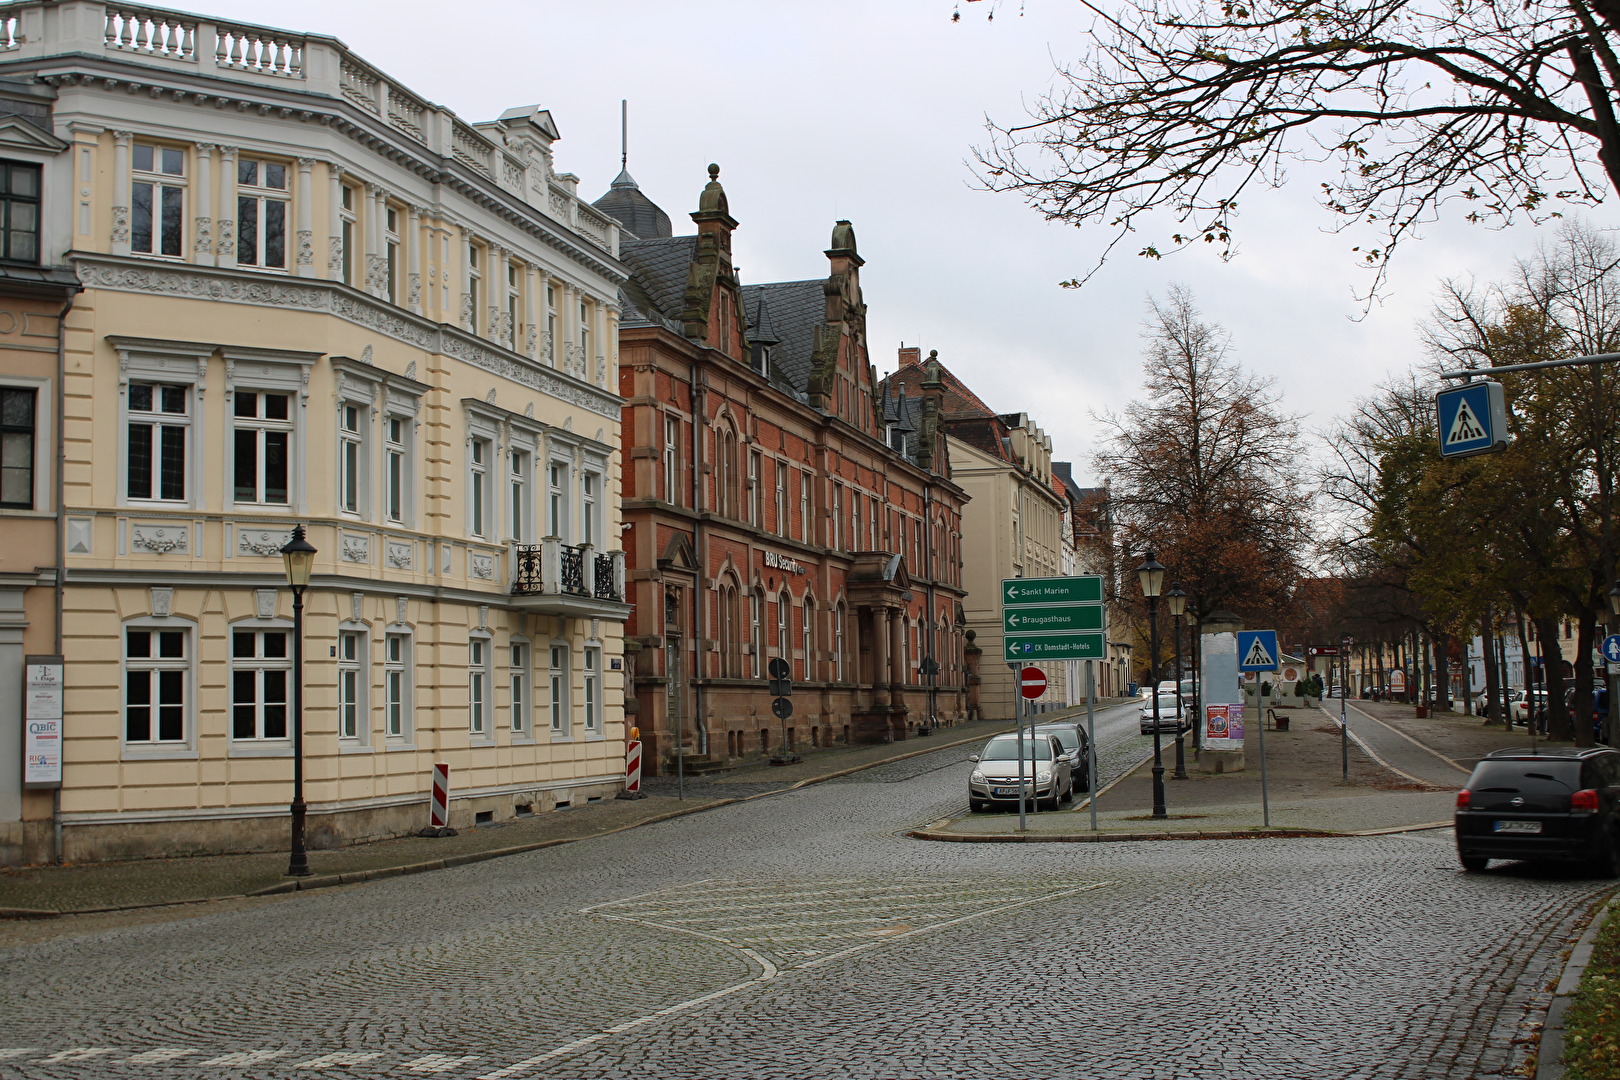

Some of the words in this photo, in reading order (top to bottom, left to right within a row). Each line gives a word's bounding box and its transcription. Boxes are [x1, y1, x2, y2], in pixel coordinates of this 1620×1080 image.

[765, 551, 778, 568] BRU
[778, 555, 798, 576] Security
[1021, 588, 1042, 596] Sankt
[1022, 615, 1071, 624] Braugasthaus
[1024, 644, 1031, 652] P
[1044, 643, 1090, 651] Domstadt-Hotels
